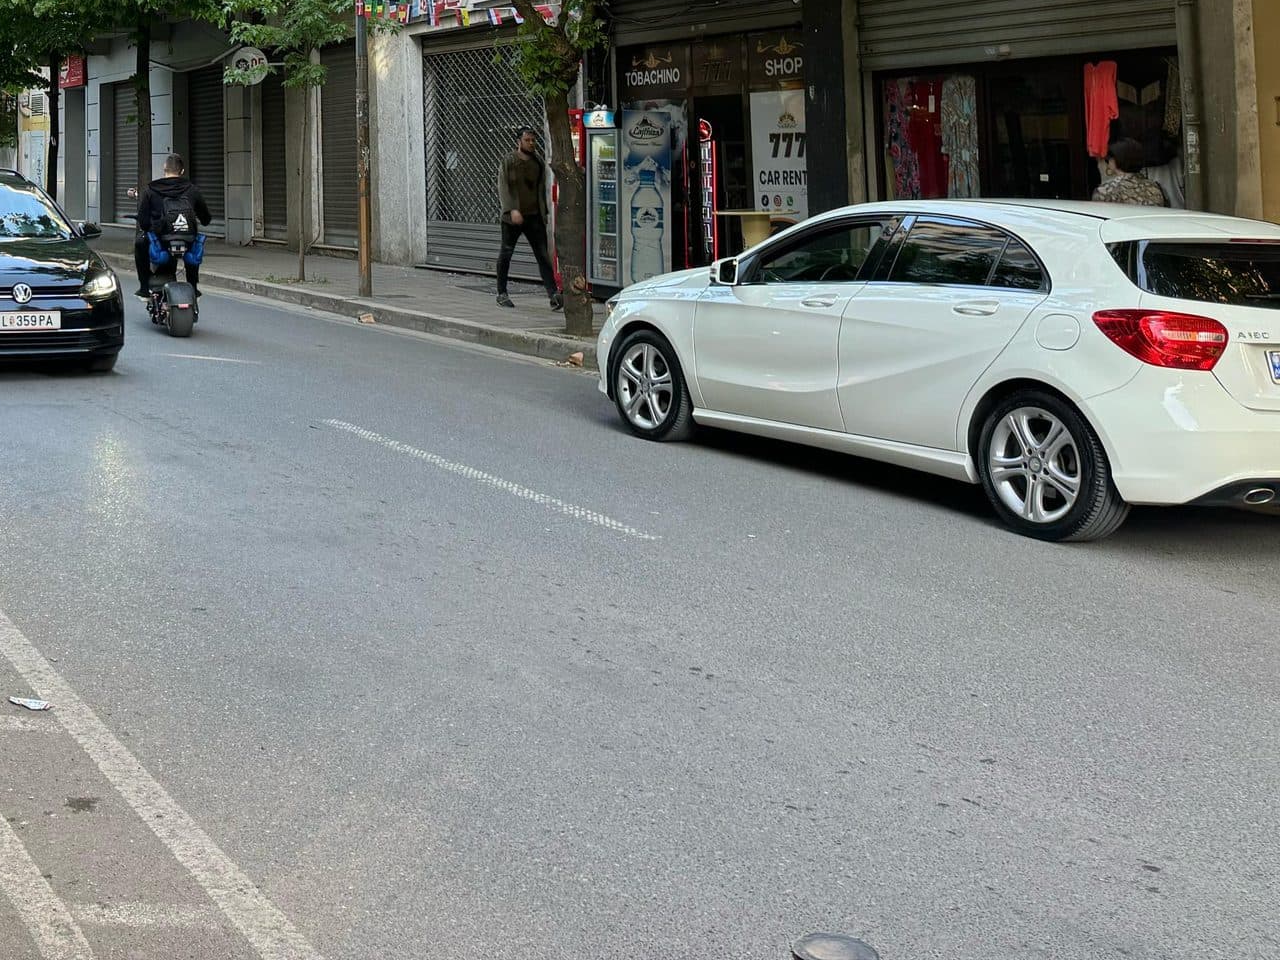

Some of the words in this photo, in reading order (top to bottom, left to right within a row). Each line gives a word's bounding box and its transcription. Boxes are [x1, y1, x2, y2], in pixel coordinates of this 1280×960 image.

[765, 57, 803, 77] SHOP
[769, 132, 806, 158] 777
[759, 170, 780, 185] CAR
[782, 170, 807, 186] RENT
